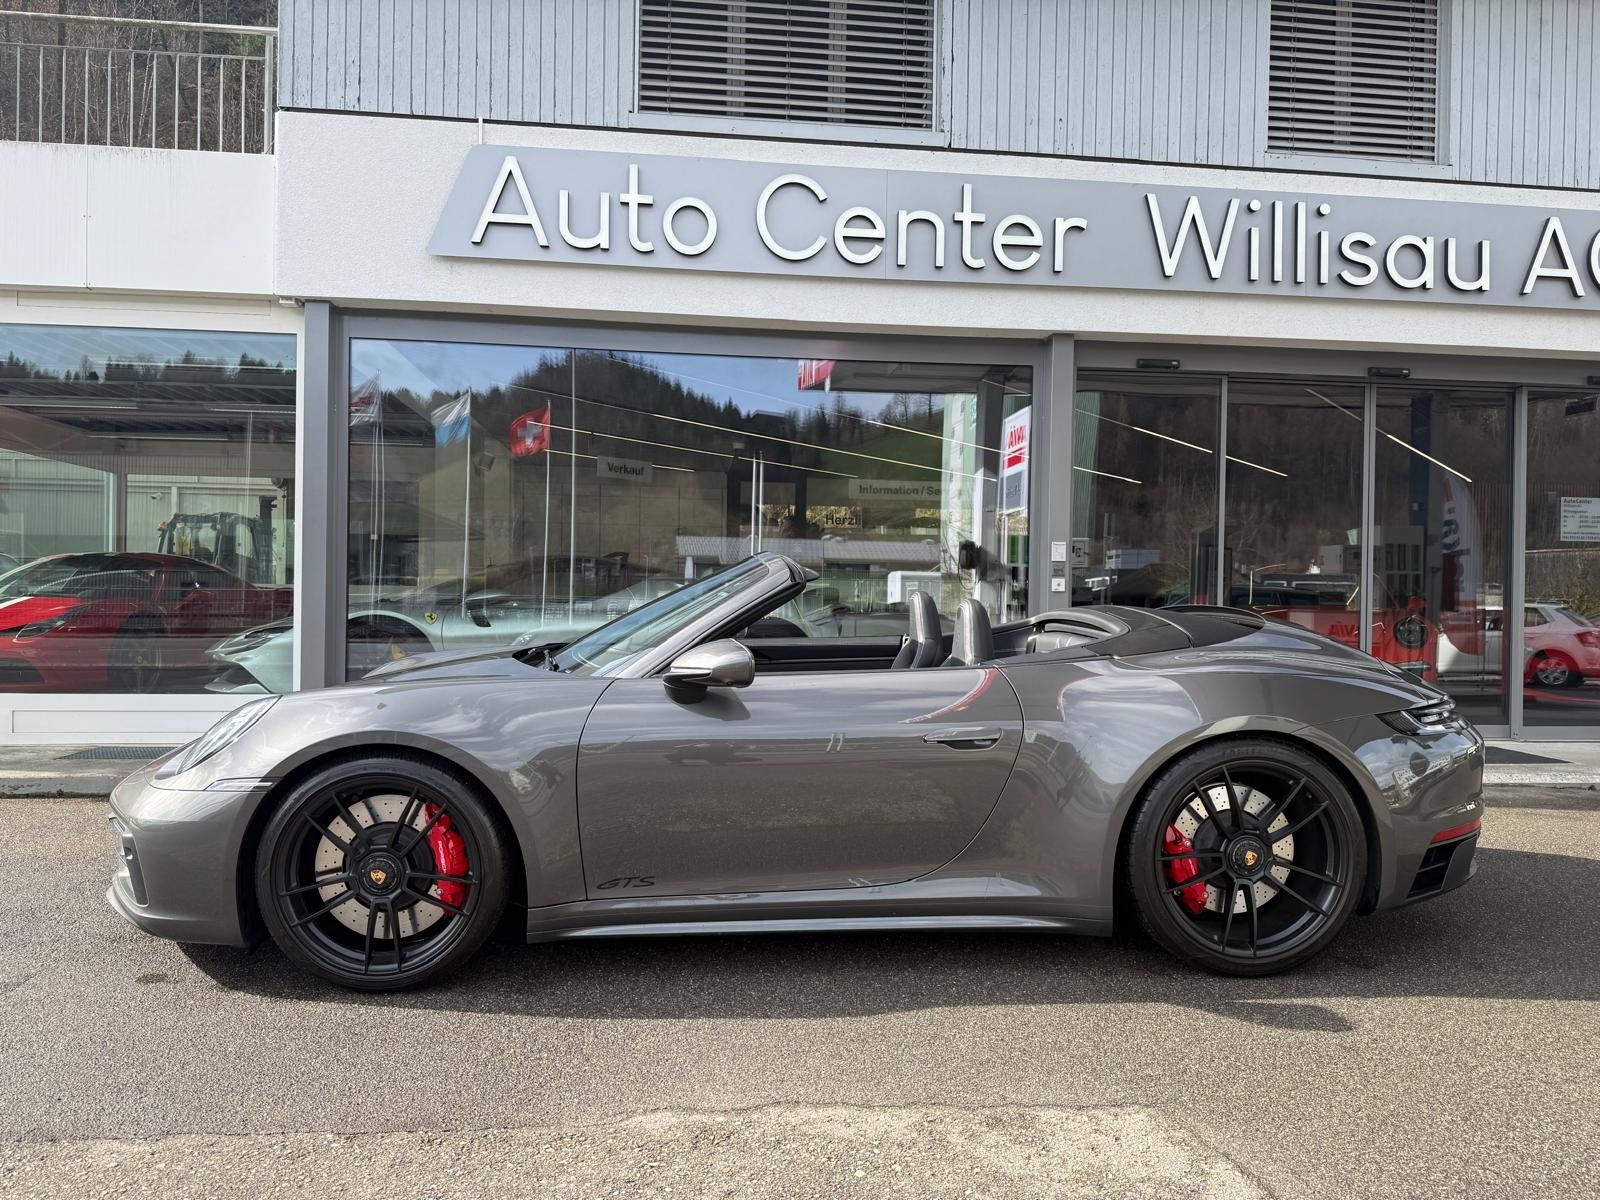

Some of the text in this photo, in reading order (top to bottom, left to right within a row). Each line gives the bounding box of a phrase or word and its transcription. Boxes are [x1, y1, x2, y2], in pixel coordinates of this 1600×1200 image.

[471, 155, 1600, 298] Auto Center Willisau A
[607, 461, 645, 476] Verkauf
[859, 484, 919, 497] Information
[596, 875, 656, 890] GTS
